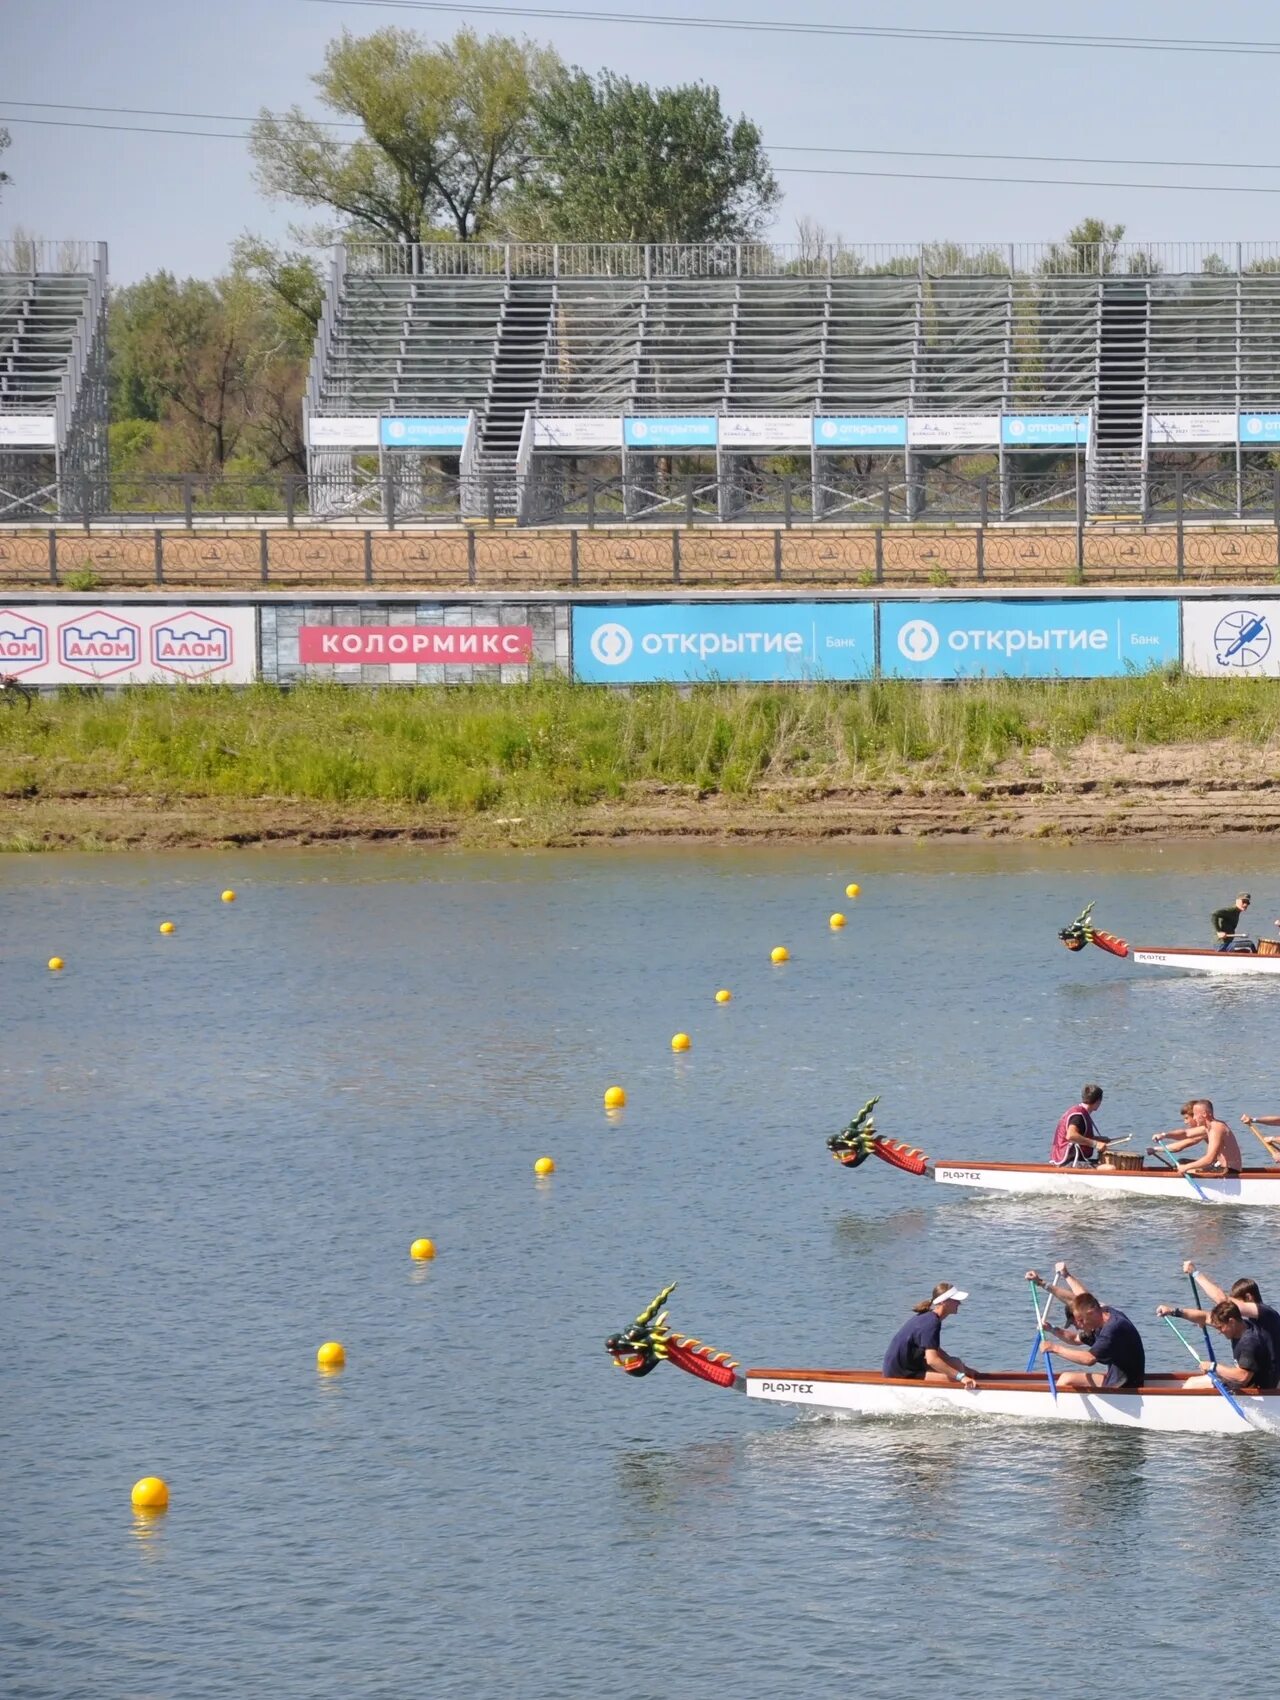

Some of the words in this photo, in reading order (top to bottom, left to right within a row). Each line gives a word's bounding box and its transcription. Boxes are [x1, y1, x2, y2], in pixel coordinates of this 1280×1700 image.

[321, 633, 522, 656] КОЛОРМИКС
[641, 631, 803, 661] открытие
[826, 635, 856, 648] Банк
[948, 628, 1108, 657] открытие
[1130, 633, 1160, 646] Банк
[69, 643, 131, 656] АЛОМ
[161, 643, 222, 657] АЛОМ
